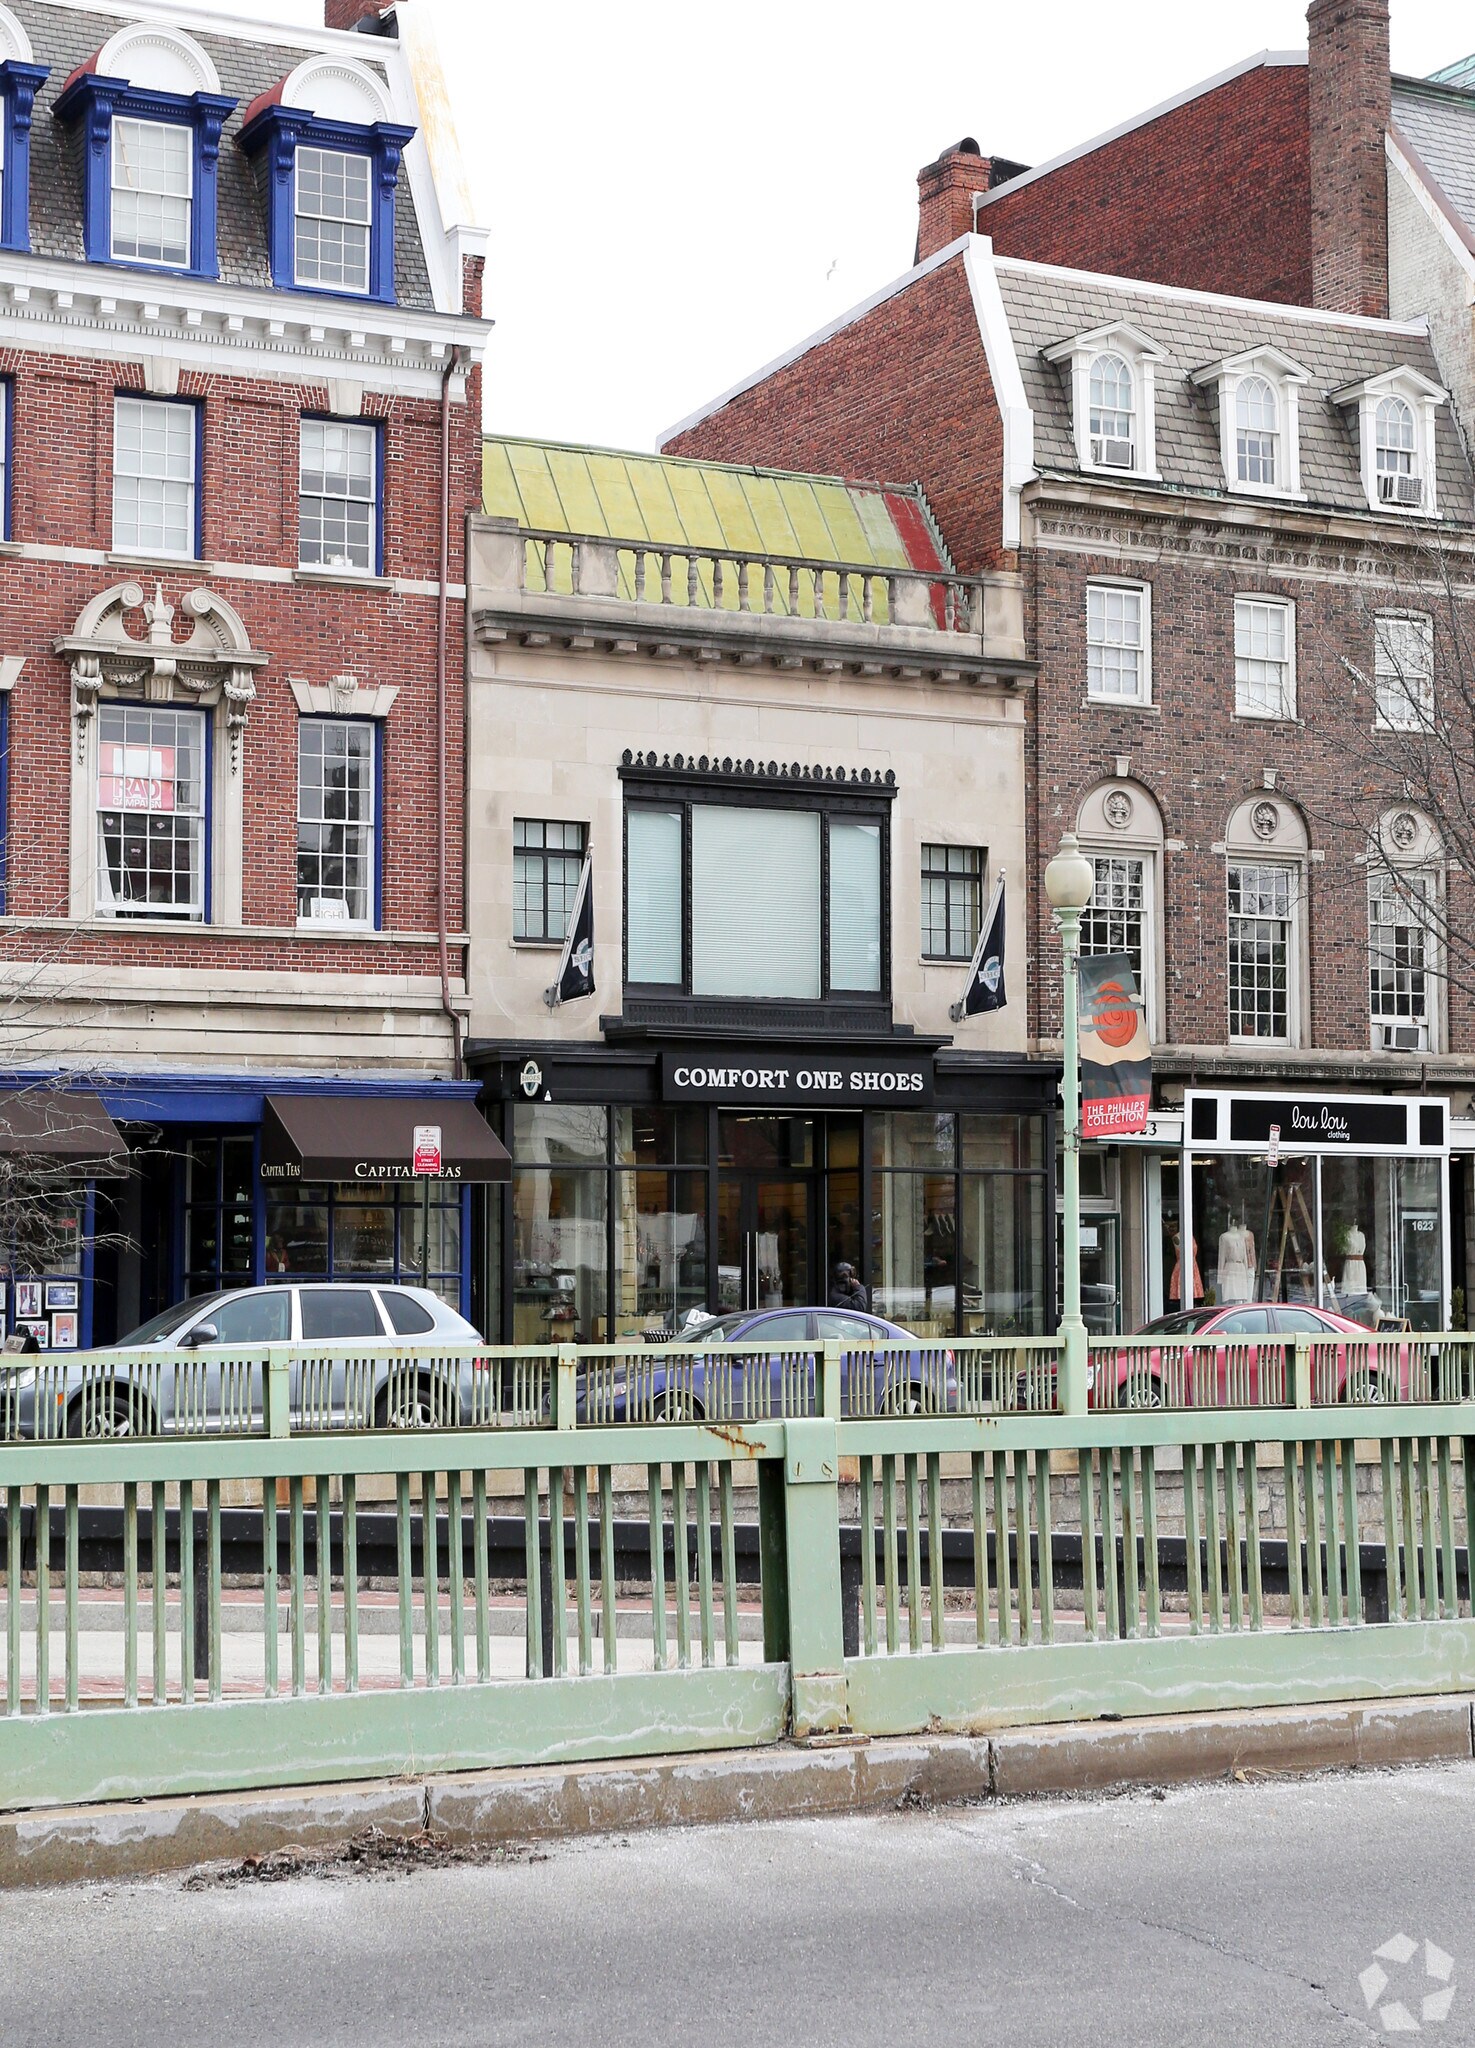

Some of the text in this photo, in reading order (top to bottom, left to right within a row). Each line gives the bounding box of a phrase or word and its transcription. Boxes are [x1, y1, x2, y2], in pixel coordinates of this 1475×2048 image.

[113, 777, 162, 799] RAD
[521, 1074, 541, 1082] SHOES
[674, 1068, 924, 1091] COMFORT ONE SHOES
[1087, 1101, 1145, 1116] THE PHILLIPS
[1087, 1111, 1144, 1127] COLLECTION
[1291, 1105, 1348, 1130] lou lou
[1327, 1130, 1350, 1141] clothing
[428, 1165, 461, 1177] EAS
[1411, 1220, 1434, 1231] 1623
